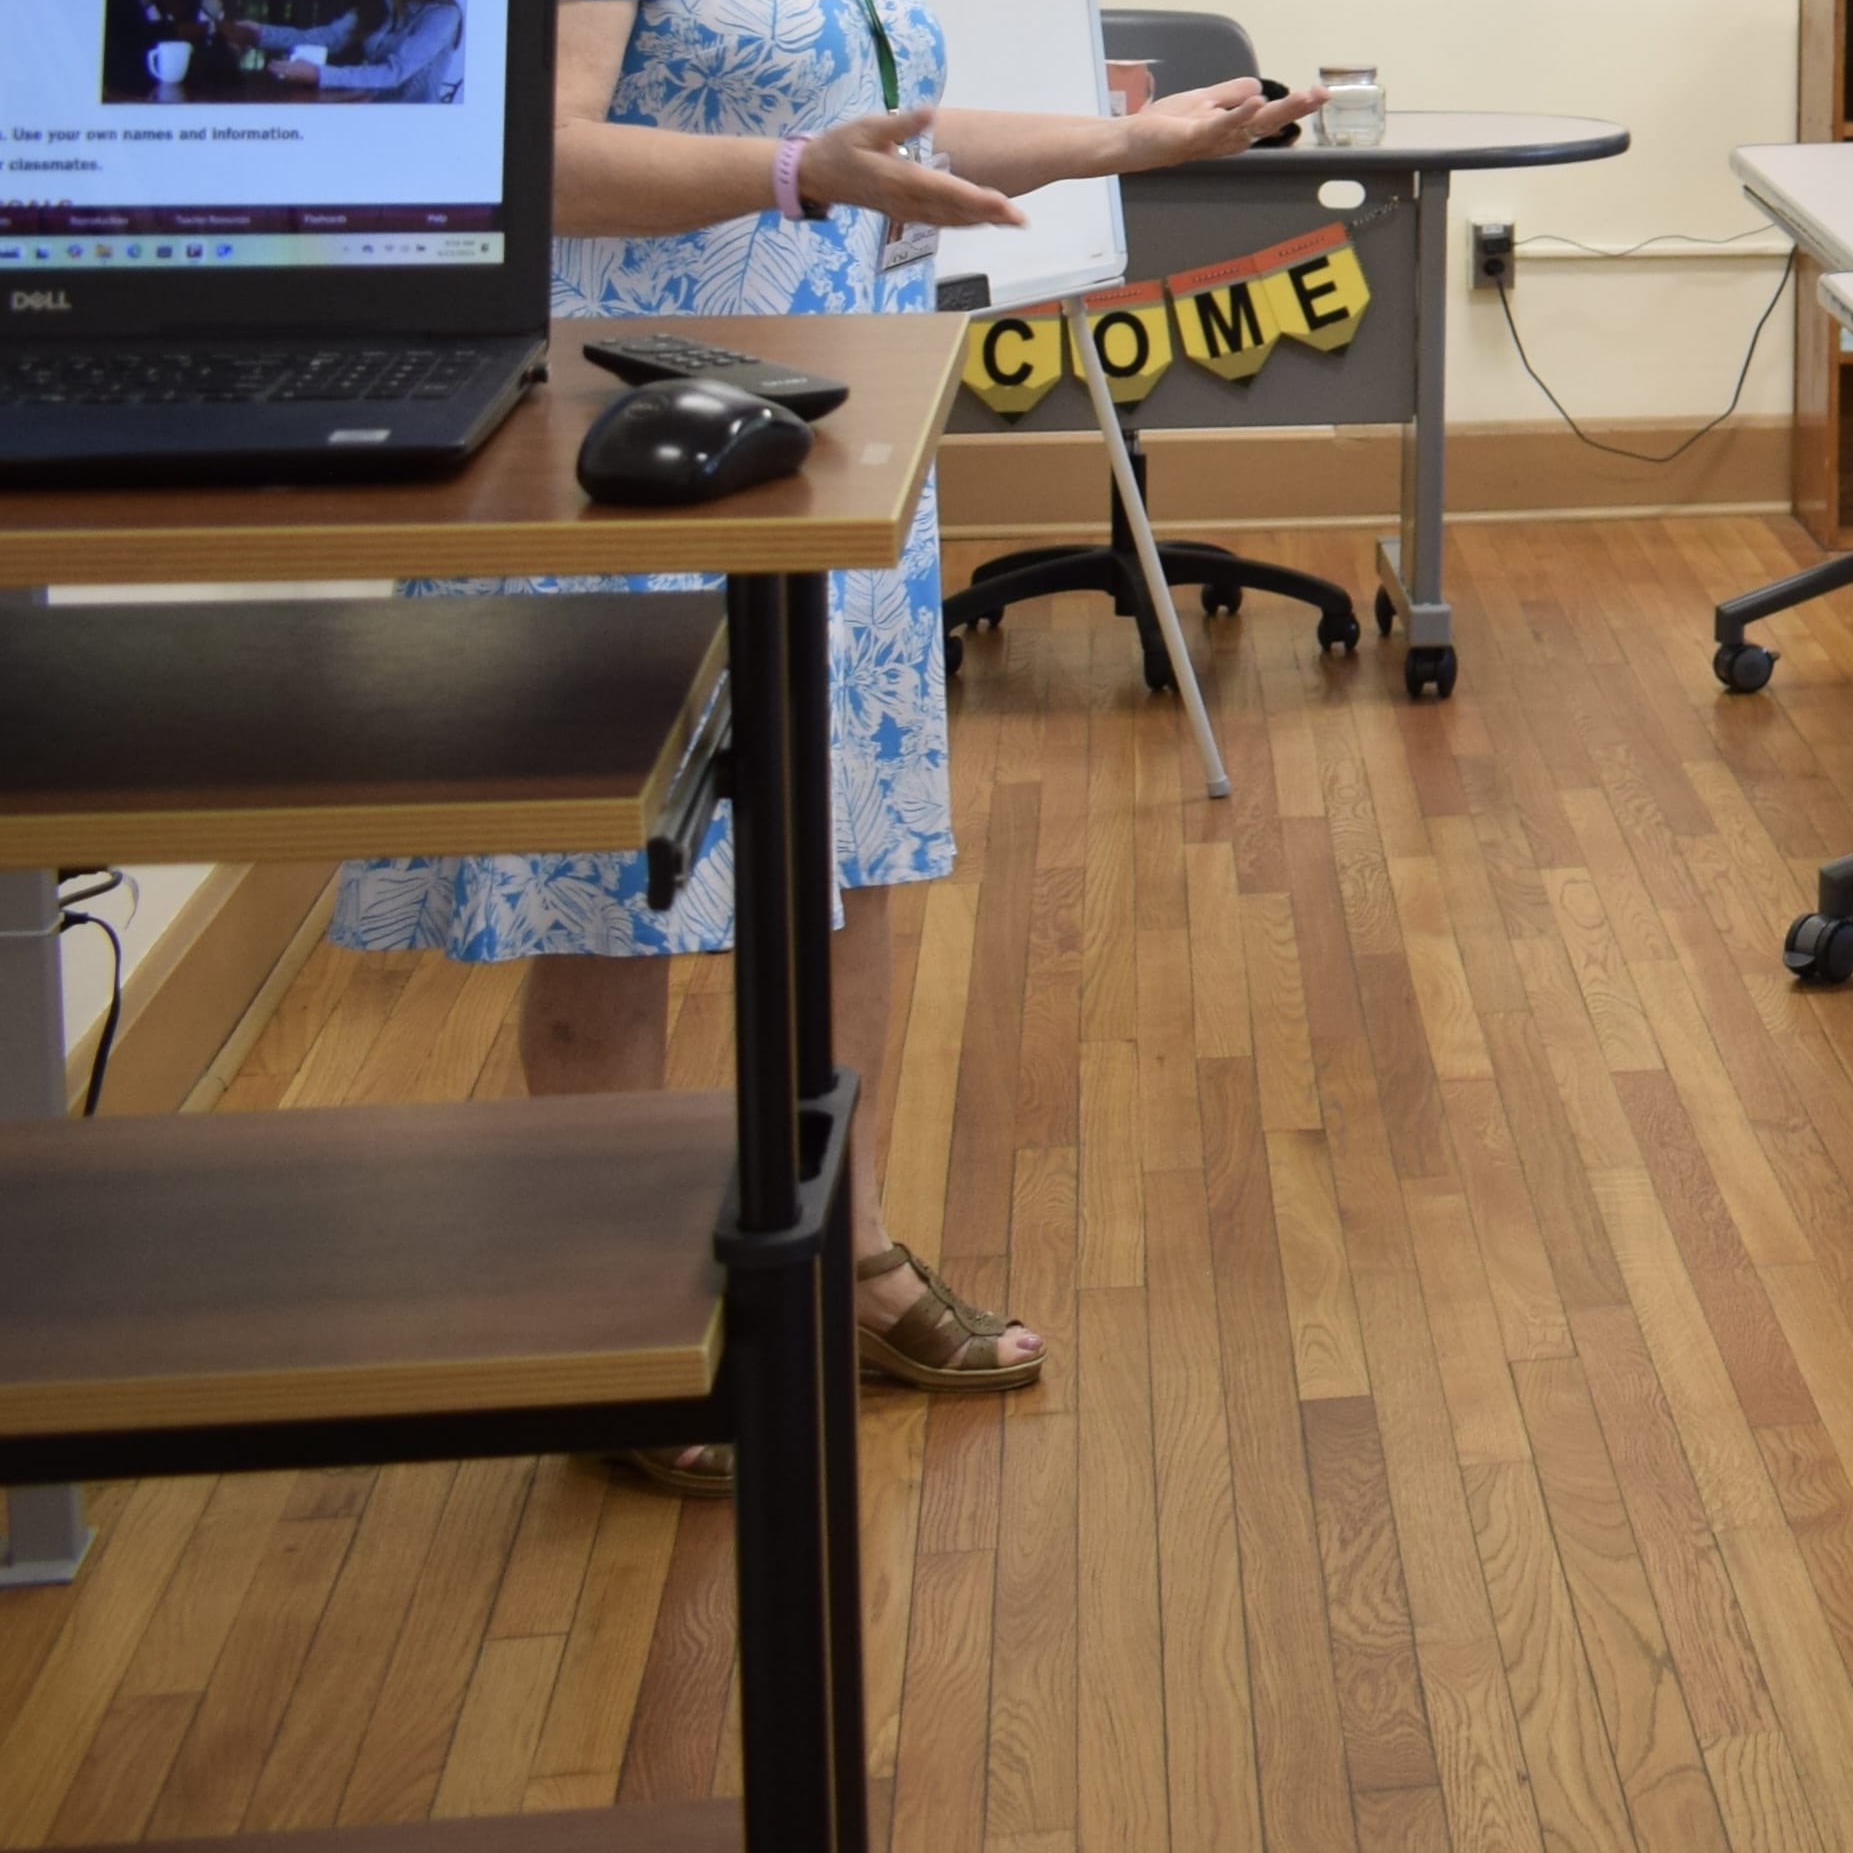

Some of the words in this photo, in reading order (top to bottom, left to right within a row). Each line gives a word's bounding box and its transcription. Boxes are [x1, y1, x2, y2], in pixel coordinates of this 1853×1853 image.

[12, 128, 41, 140] Use
[48, 129, 80, 144] your
[86, 129, 117, 141] own
[123, 129, 173, 141] names
[179, 127, 206, 140] and
[212, 127, 304, 140] information.
[9, 158, 103, 171] classmates.
[11, 291, 72, 310] DELL
